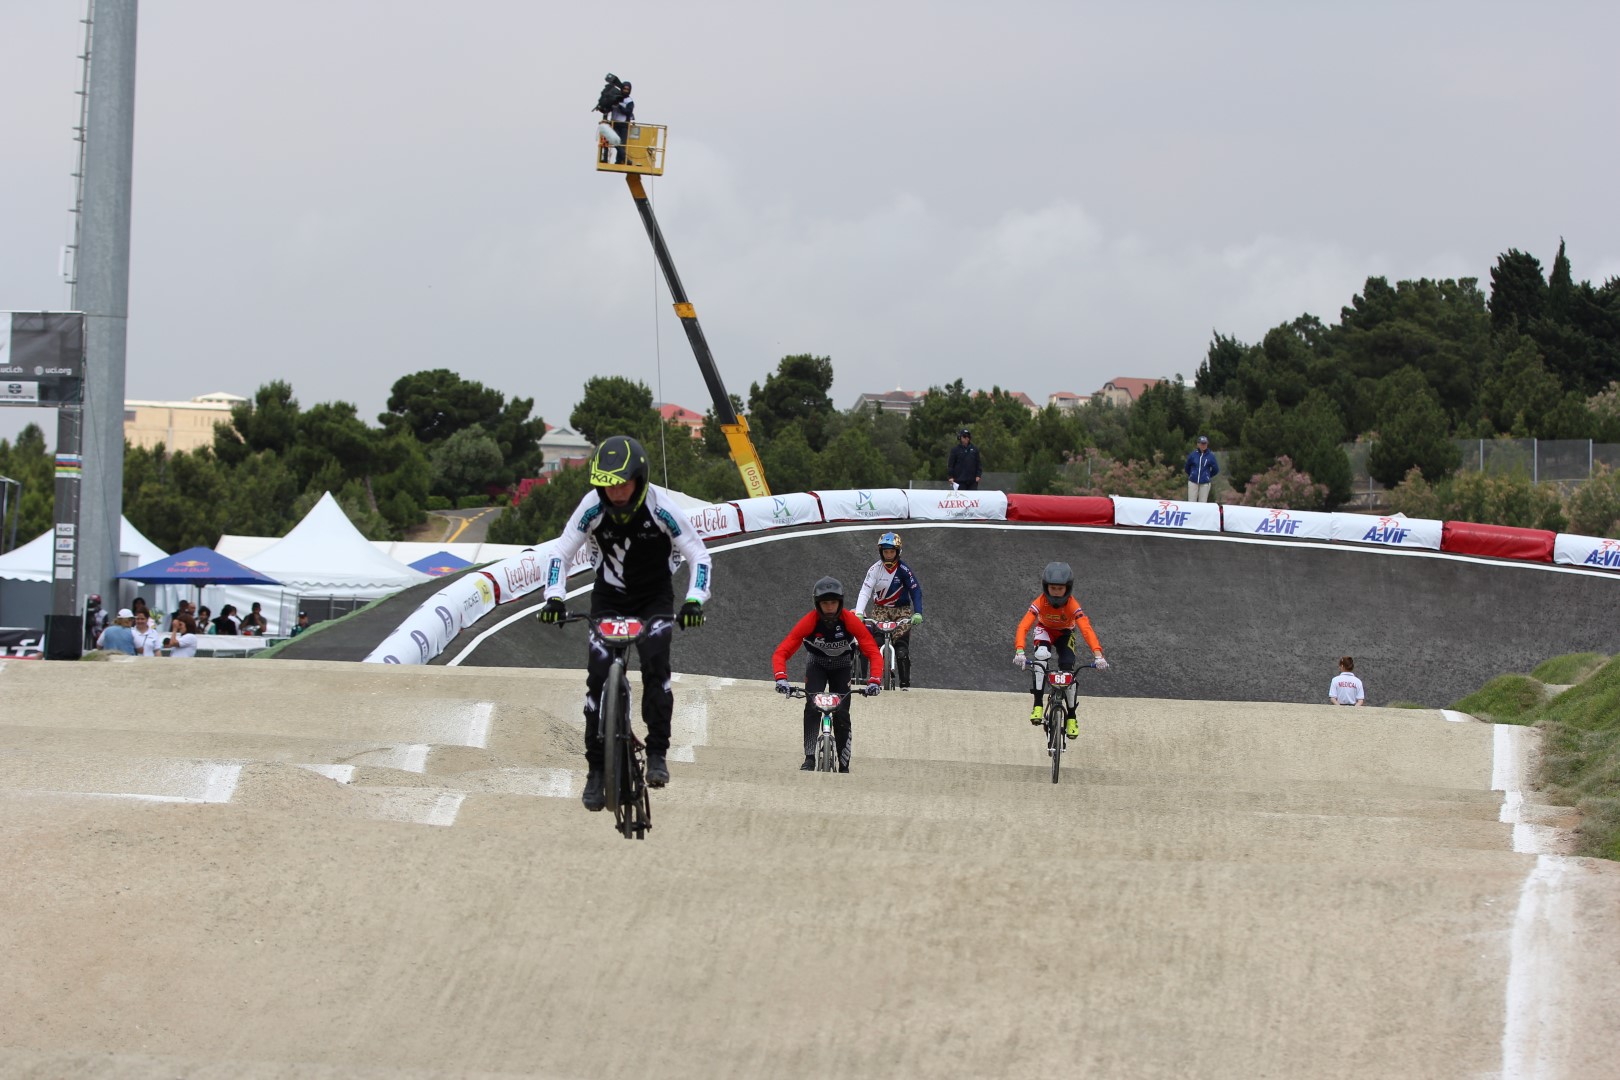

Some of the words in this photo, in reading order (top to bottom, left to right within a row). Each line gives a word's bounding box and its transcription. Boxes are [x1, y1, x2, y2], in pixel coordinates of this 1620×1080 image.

[45, 367, 72, 376] uci.org
[745, 466, 761, 490] (055)
[937, 499, 980, 510] AZERÇAY
[1583, 549, 1620, 567] AzVi
[611, 621, 629, 635] 73
[1054, 674, 1066, 685] 68
[821, 696, 834, 706] 63
